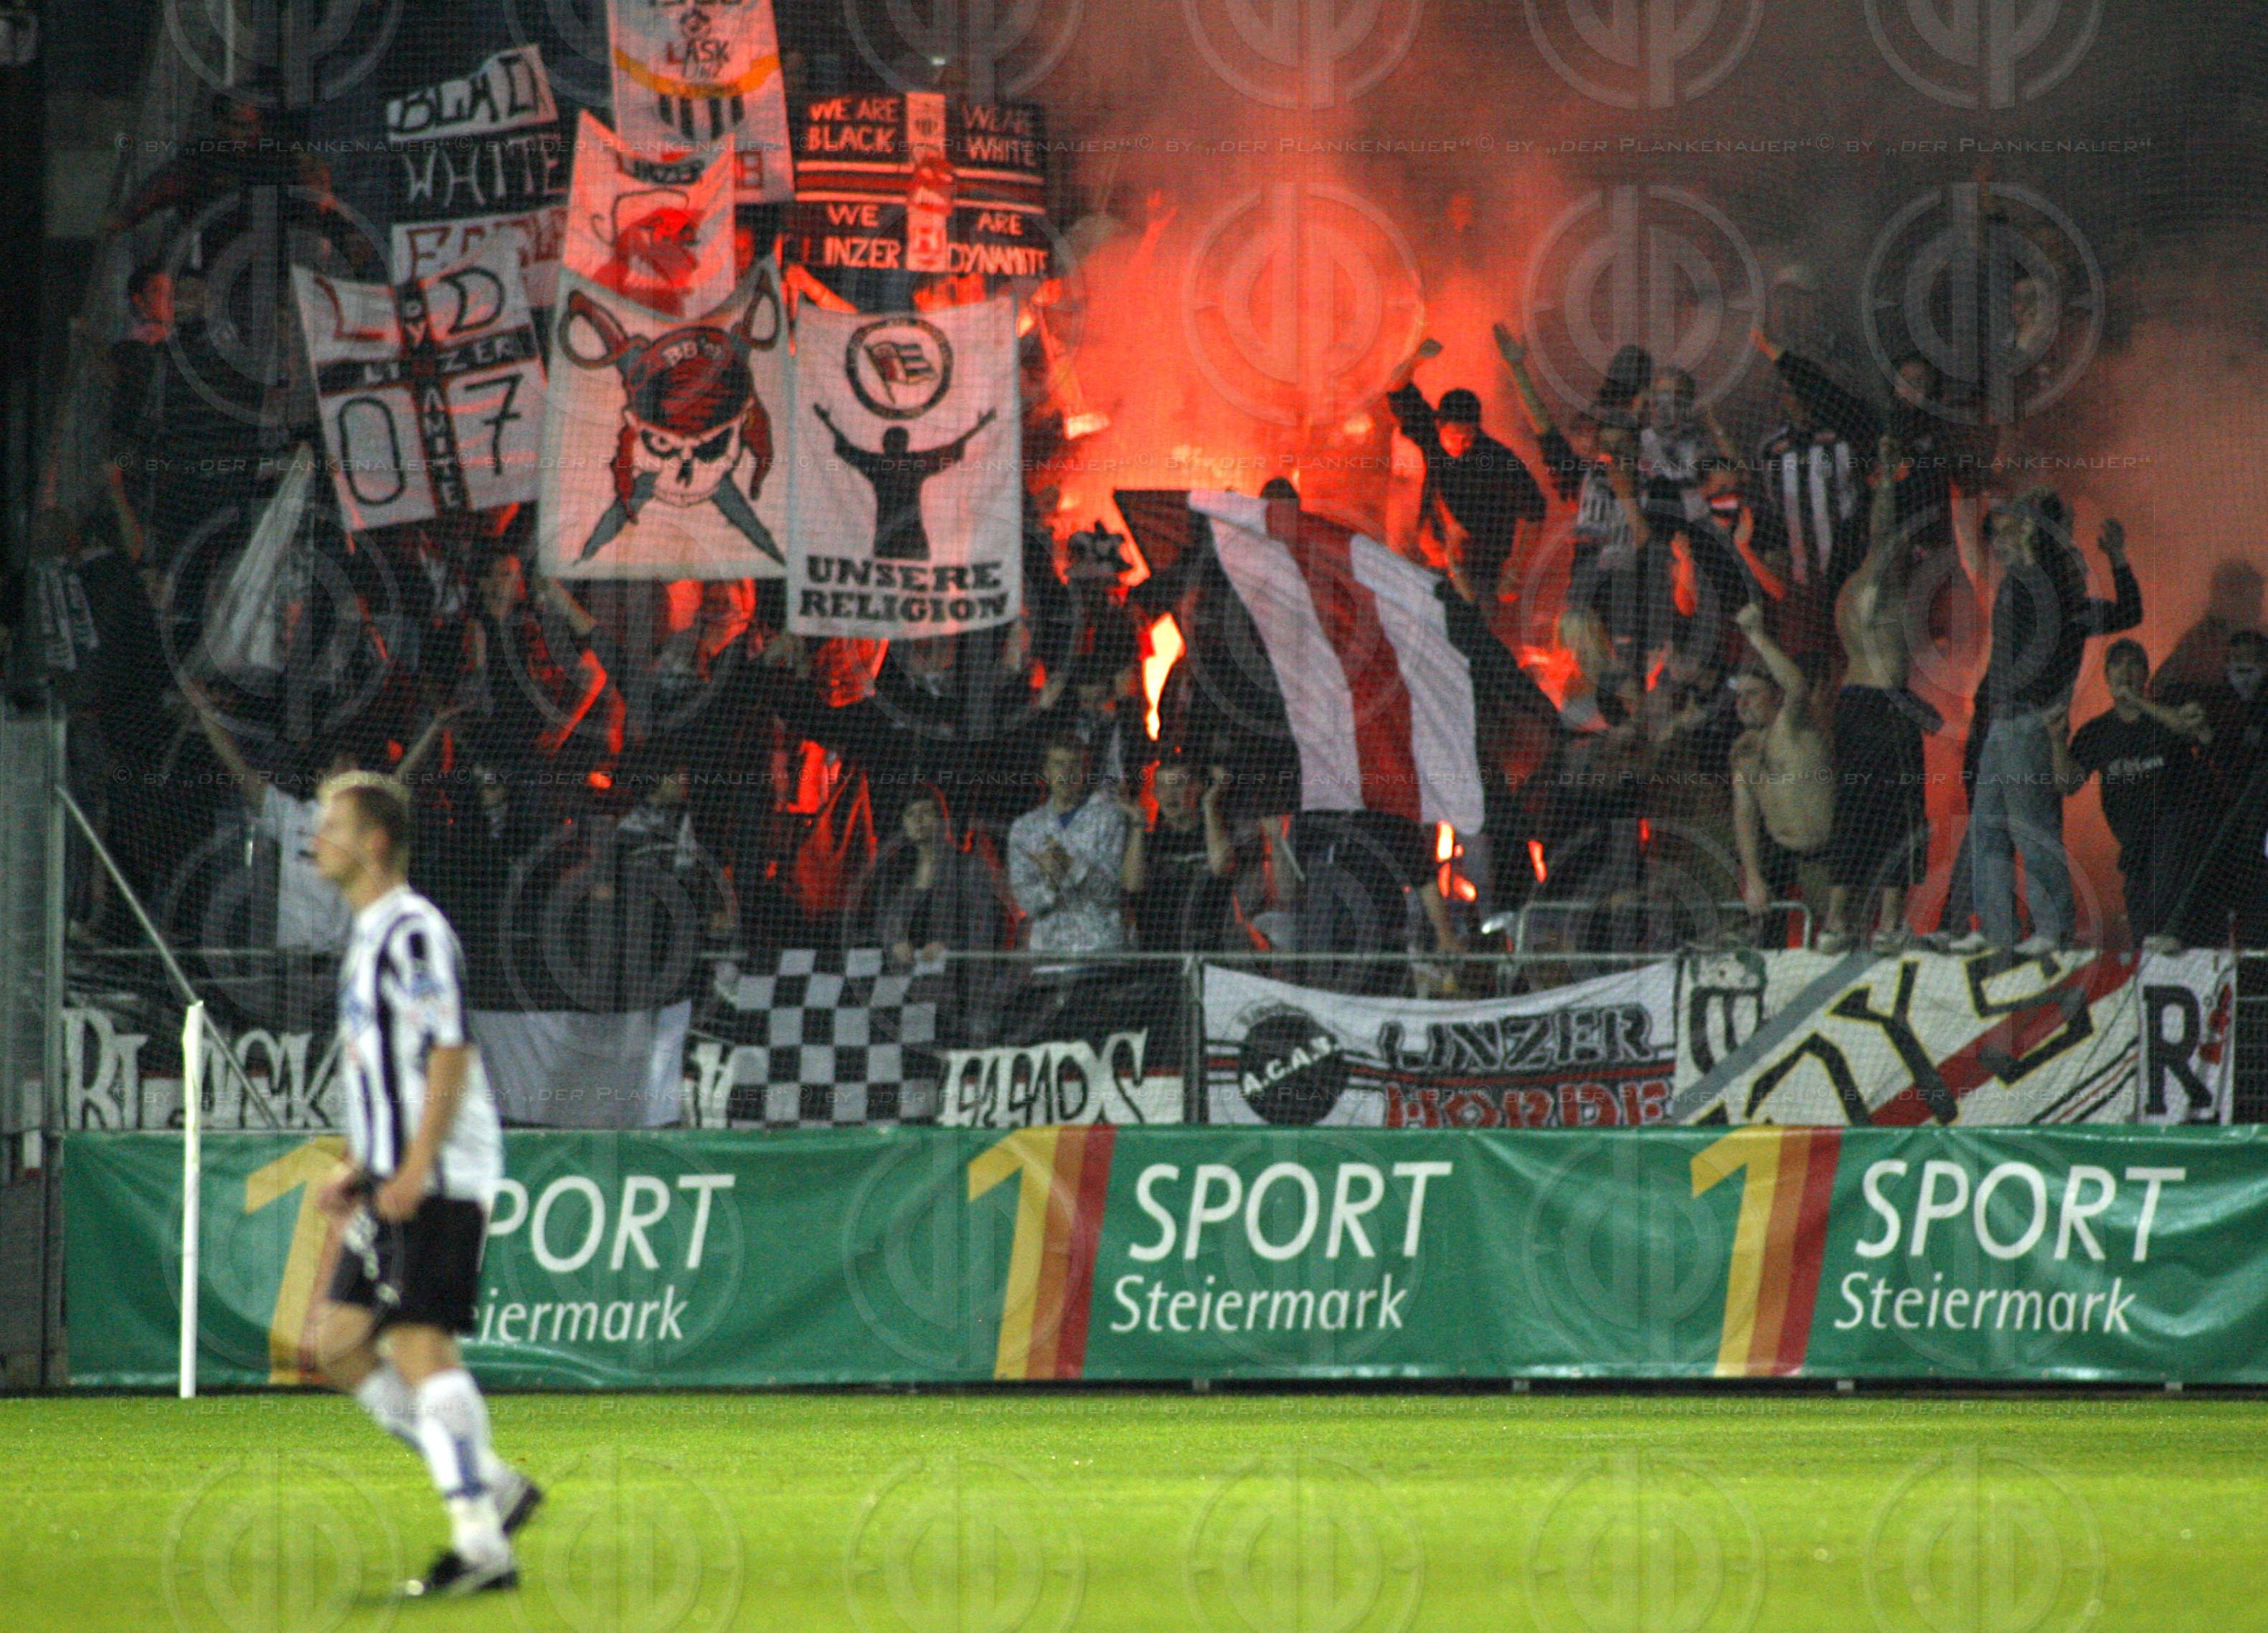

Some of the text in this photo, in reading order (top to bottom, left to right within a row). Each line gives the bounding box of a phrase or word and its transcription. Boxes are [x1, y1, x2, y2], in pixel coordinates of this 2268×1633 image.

[807, 125, 896, 153] BLACK
[856, 99, 899, 122] ARE
[827, 203, 1024, 235] WE ARE
[806, 555, 1003, 592] UNSERE
[799, 590, 1008, 623] RELIGION
[1378, 1005, 1652, 1072] LINZER
[476, 1174, 736, 1272] PORT
[1128, 1160, 1452, 1261] SPORT
[1855, 1159, 2186, 1262] SPORT
[470, 1284, 688, 1343] iermark
[1110, 1273, 1408, 1332] Steiermark
[1833, 1272, 2137, 1334] Steiermark
